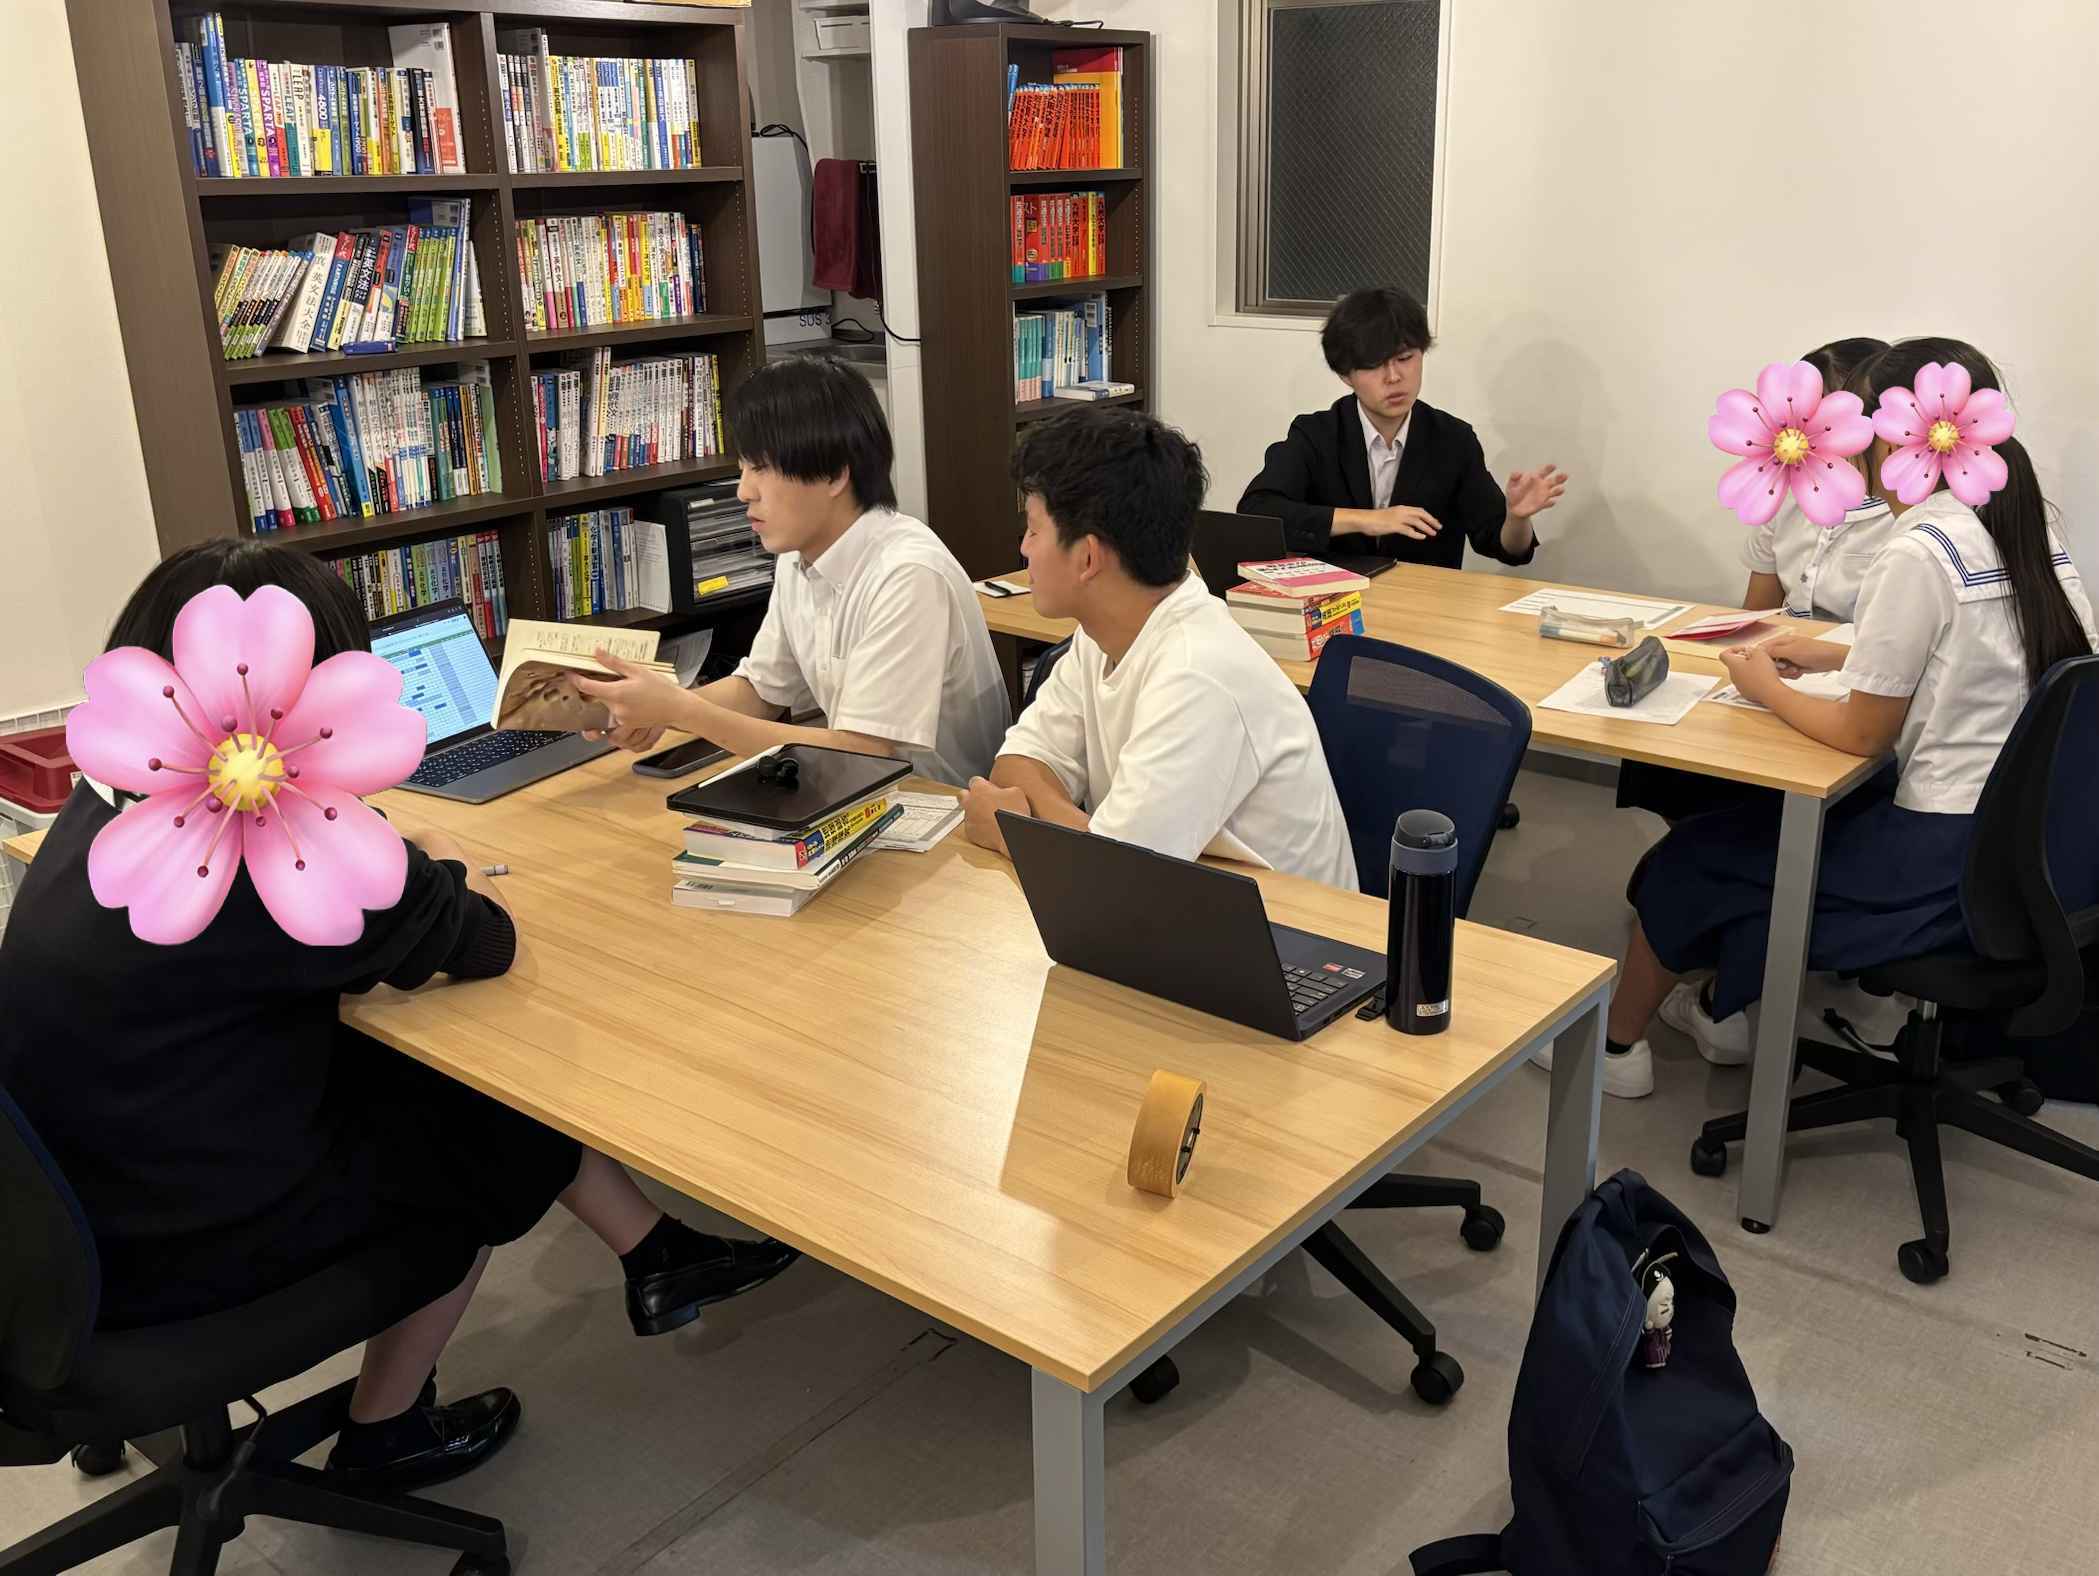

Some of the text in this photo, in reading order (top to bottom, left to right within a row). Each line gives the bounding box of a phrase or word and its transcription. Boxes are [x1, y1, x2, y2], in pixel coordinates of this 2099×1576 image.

[239, 87, 251, 135] SPARTA
[293, 75, 304, 100] LEAP
[260, 88, 275, 137] SPARTA
